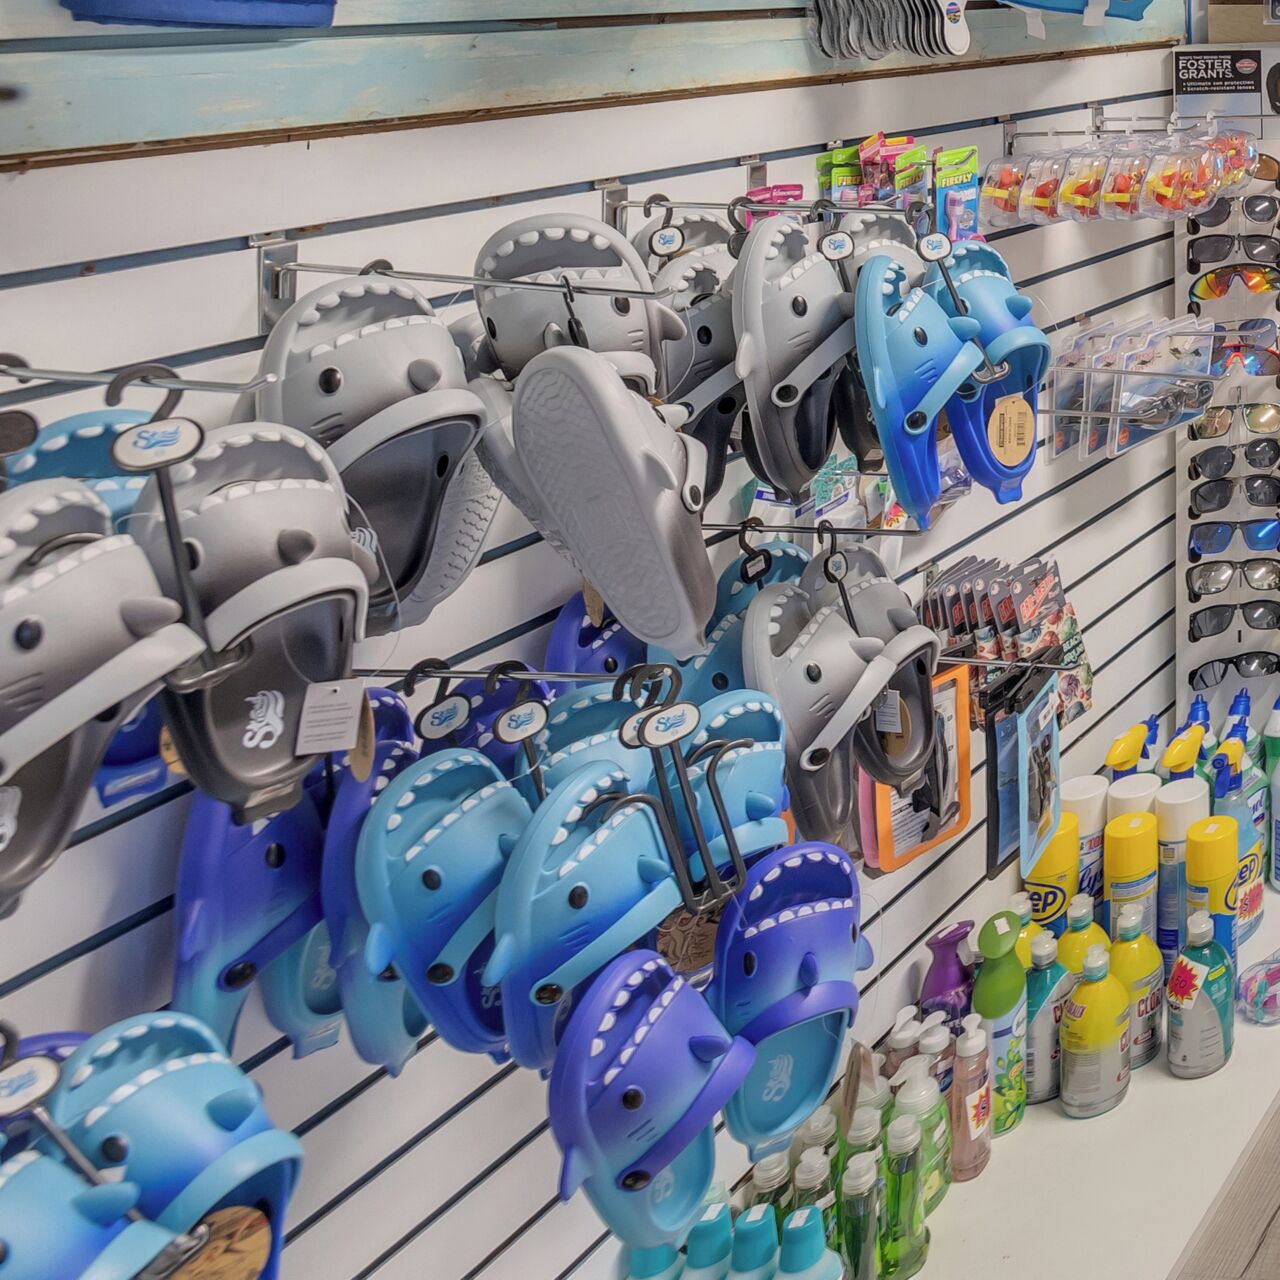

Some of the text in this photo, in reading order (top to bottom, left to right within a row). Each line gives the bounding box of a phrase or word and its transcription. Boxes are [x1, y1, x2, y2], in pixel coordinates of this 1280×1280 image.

[1178, 59, 1232, 70] FOSTER
[1178, 69, 1234, 79] GRANTS.
[940, 172, 973, 187] FIREFLY
[1237, 857, 1256, 881] ep
[1032, 890, 1058, 913] ep
